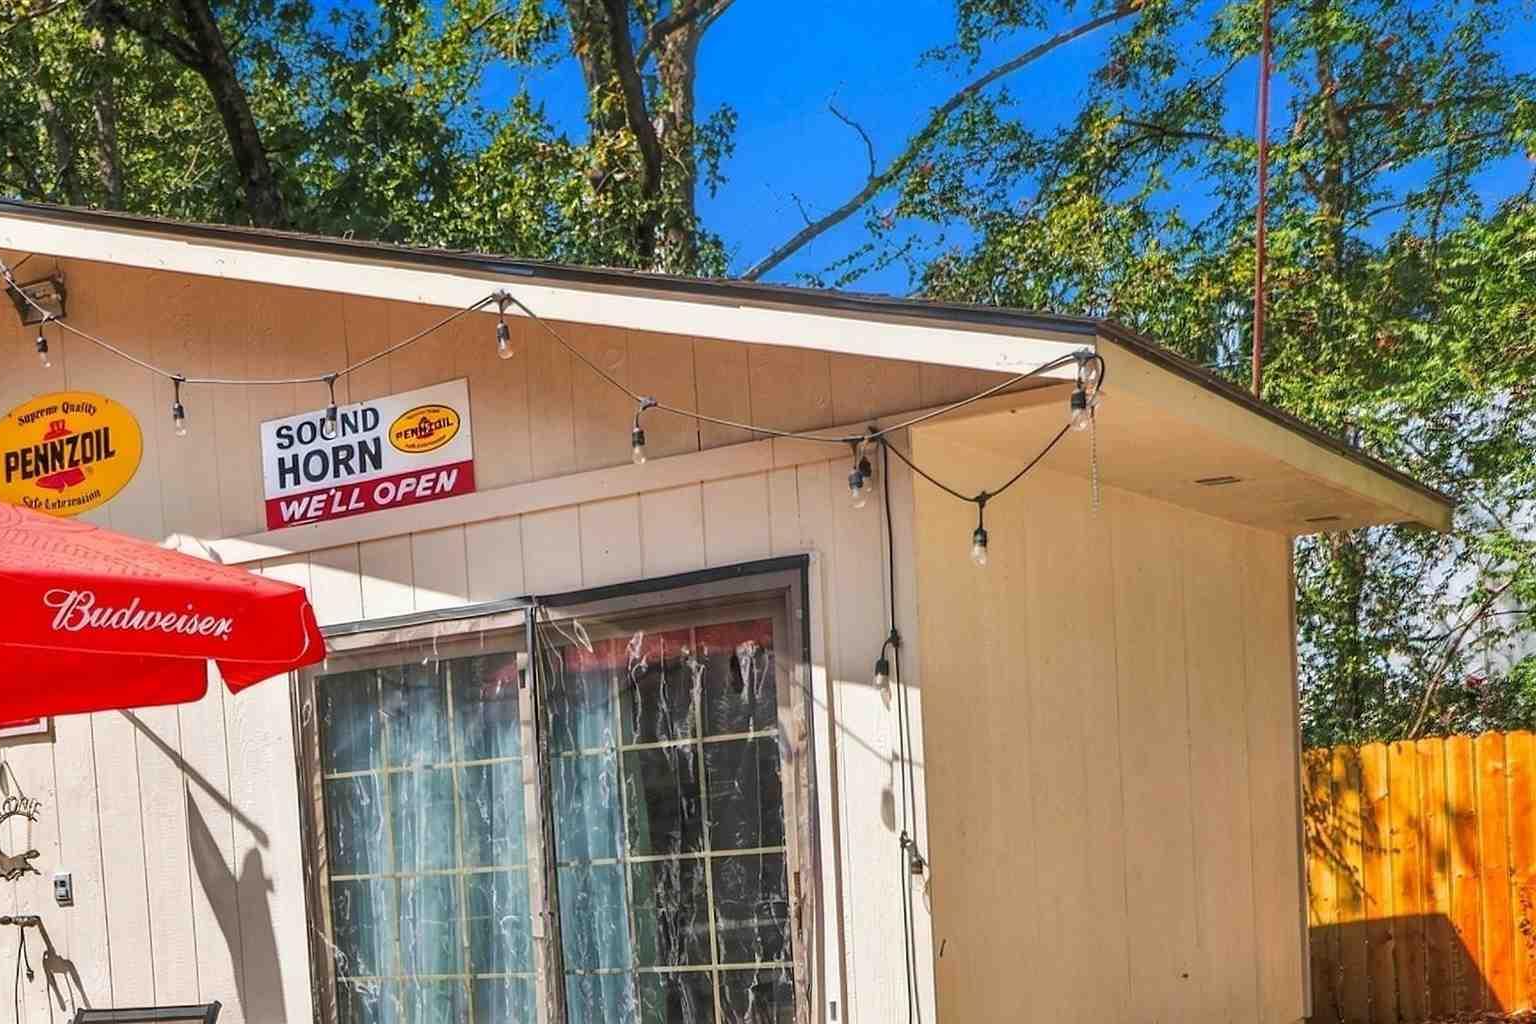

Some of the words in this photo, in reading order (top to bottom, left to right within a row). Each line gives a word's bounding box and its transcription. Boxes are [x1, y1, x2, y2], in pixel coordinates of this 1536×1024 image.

[62, 401, 97, 417] Quality
[275, 407, 380, 450] SOUND
[395, 416, 454, 440] PENNZOIL
[4, 427, 116, 484] PENNZOIL
[277, 436, 383, 489] HORN
[279, 487, 366, 522] WE'LL
[373, 468, 459, 505] OPEN
[43, 588, 233, 637] Budweiser
